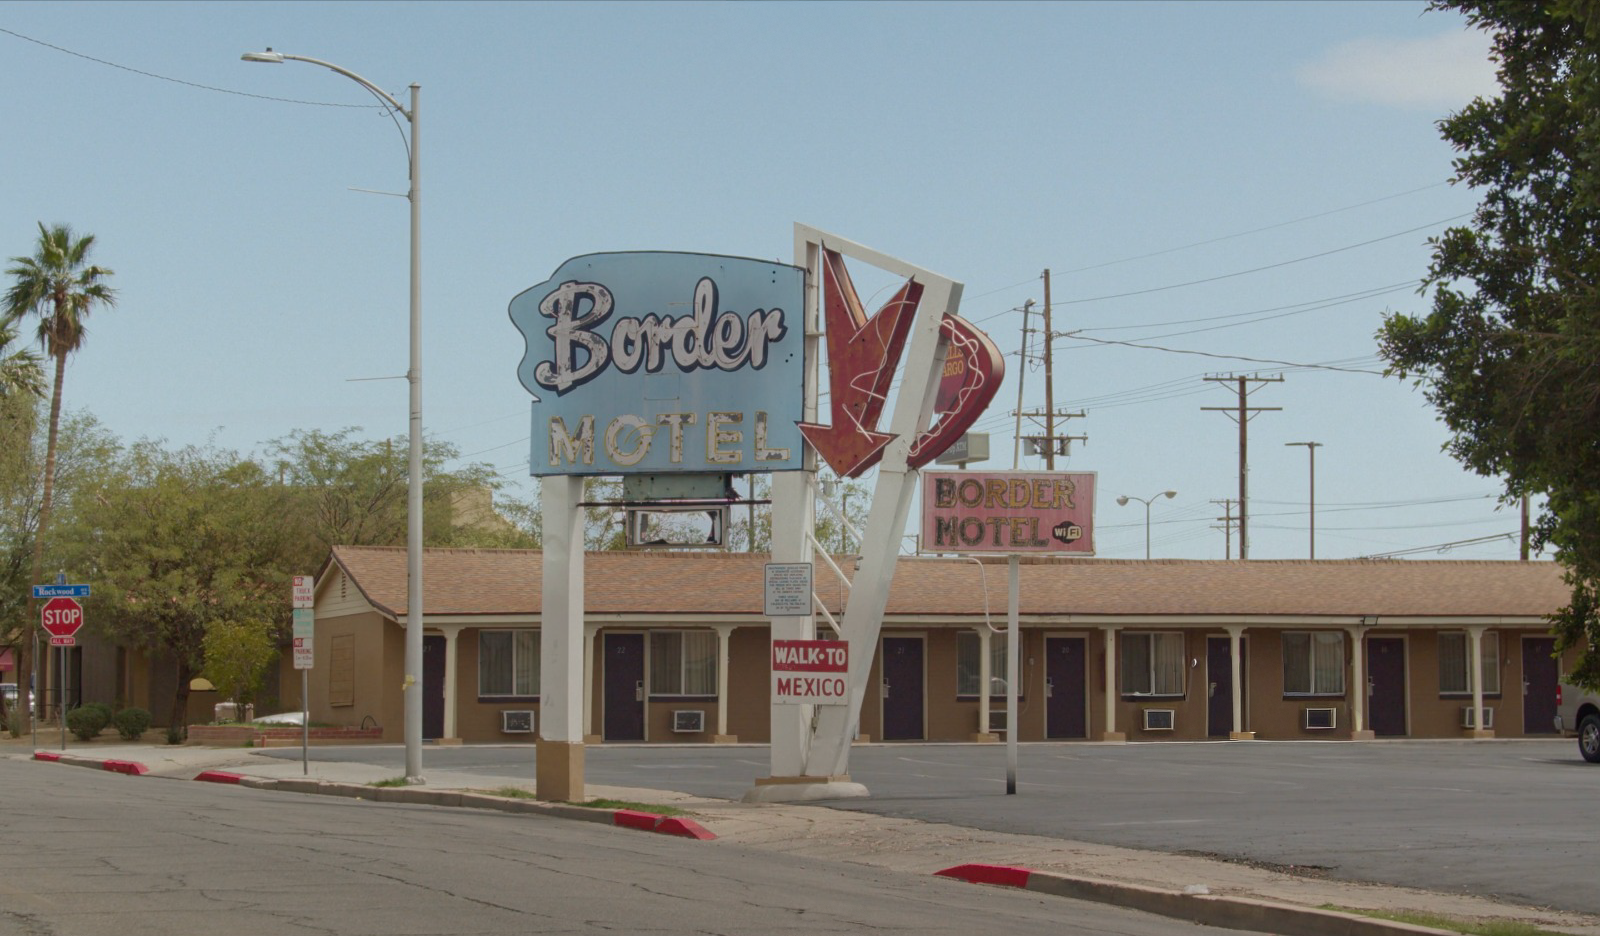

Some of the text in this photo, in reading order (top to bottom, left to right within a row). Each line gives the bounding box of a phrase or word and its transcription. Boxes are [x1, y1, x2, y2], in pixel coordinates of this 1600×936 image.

[535, 276, 788, 397] Border
[943, 360, 964, 377] ARGO
[549, 411, 790, 466] MOTEL
[935, 478, 1075, 509] BORDER
[935, 516, 1049, 547] MOTEL
[39, 587, 75, 595] Rockwood
[45, 609, 80, 624] STOP
[616, 646, 626, 654] 22
[1061, 646, 1070, 654] 20
[777, 678, 845, 696] MEXICO
